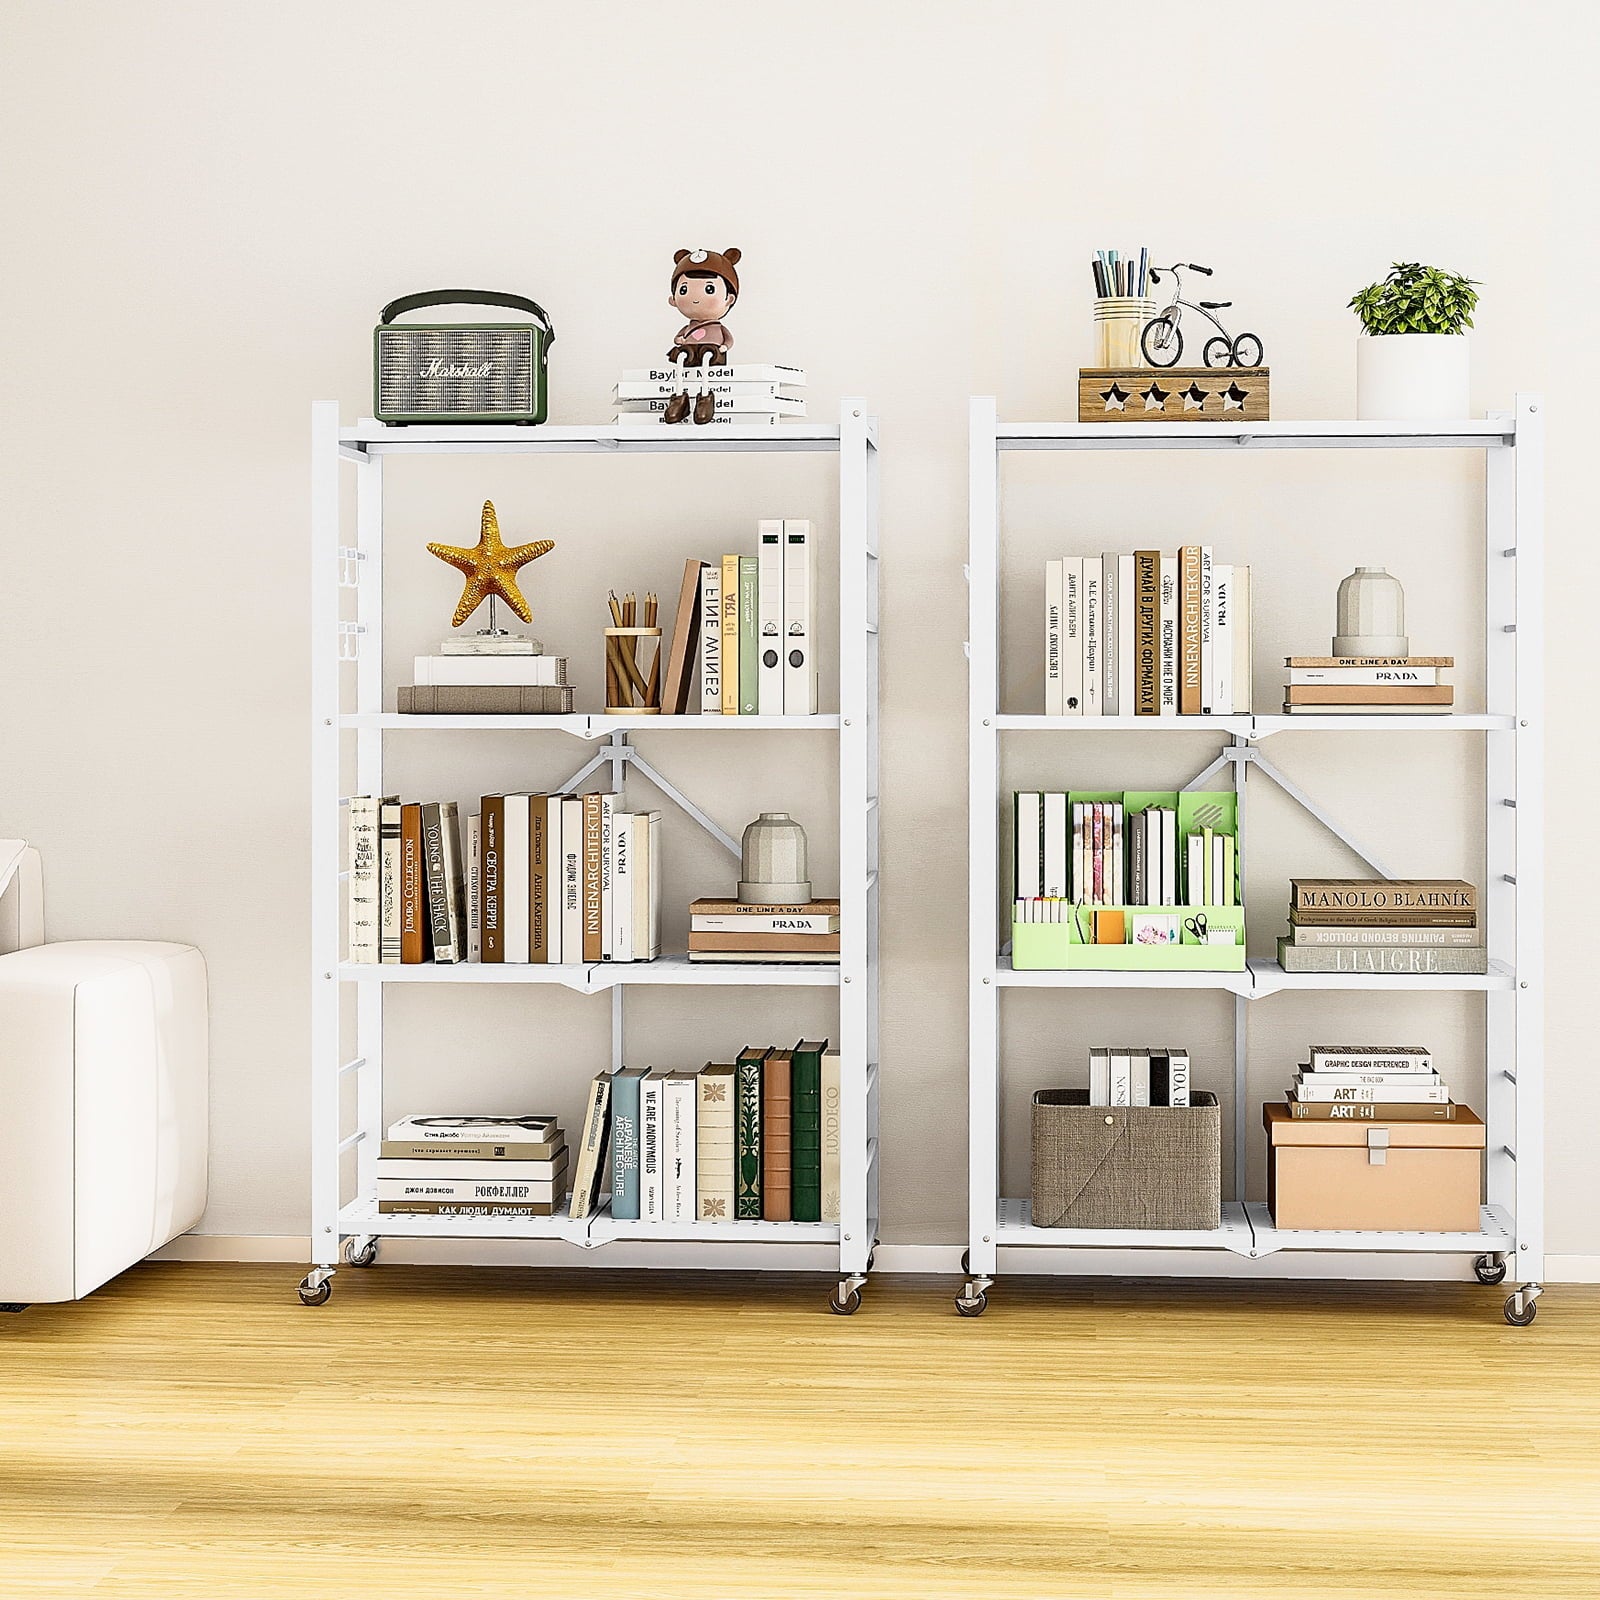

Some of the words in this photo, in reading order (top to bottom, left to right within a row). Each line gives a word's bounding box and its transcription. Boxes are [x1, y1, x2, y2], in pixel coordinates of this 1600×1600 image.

[420, 358, 493, 378] Marshall
[1068, 574, 1076, 598] ДАНТЕ
[1140, 556, 1155, 592] ДУМАЙ
[1186, 546, 1199, 688] INNENARCHITEKTUR
[1218, 583, 1226, 626] PRADA
[1140, 606, 1154, 646] ДРУГИХ
[1163, 620, 1173, 658] РАССКАЖИ
[1050, 632, 1058, 670] ВЕЧНОМУ
[1141, 648, 1154, 704] ФОРМАТАХ
[1163, 661, 1173, 676] МНЕ
[1163, 685, 1173, 706] МОРЕ
[428, 823, 441, 863] YOUNG
[618, 832, 627, 874] PRADA
[404, 838, 414, 898] COLLECTION
[486, 850, 497, 892] СЕСТРА
[587, 794, 599, 935] INNENARCHITEKTUR
[430, 873, 444, 895] THE
[534, 873, 542, 900] АННА
[1302, 891, 1387, 907] MANOLO
[1394, 890, 1471, 906] BLAHNÍK
[404, 901, 416, 934] JUMBO
[432, 898, 448, 933] SHACK
[486, 895, 497, 930] КЕРРИ
[534, 902, 542, 950] КАРЕНИНА
[772, 920, 812, 928] PRADA
[1317, 933, 1358, 942] POLLOCK
[1361, 933, 1399, 942] BEYOND
[1401, 933, 1445, 942] PAINTING
[1336, 950, 1438, 972] LIAIGRE
[1174, 1063, 1186, 1092] YOU
[1334, 1088, 1357, 1100] ART
[646, 1091, 656, 1105] WE
[646, 1106, 656, 1122] ARE
[1330, 1105, 1357, 1118] ART
[826, 1087, 839, 1156] LUXDECO
[615, 1115, 624, 1197] ARCHITECTURE
[624, 1116, 633, 1169] JAPANESE
[646, 1123, 656, 1174] ANONYMOUS
[475, 1186, 530, 1198] РОКФЕЛЛЕР
[438, 1206, 457, 1214] КАК
[459, 1206, 488, 1215] ЛЮДИ
[491, 1207, 533, 1215] ДУМАЮТ
